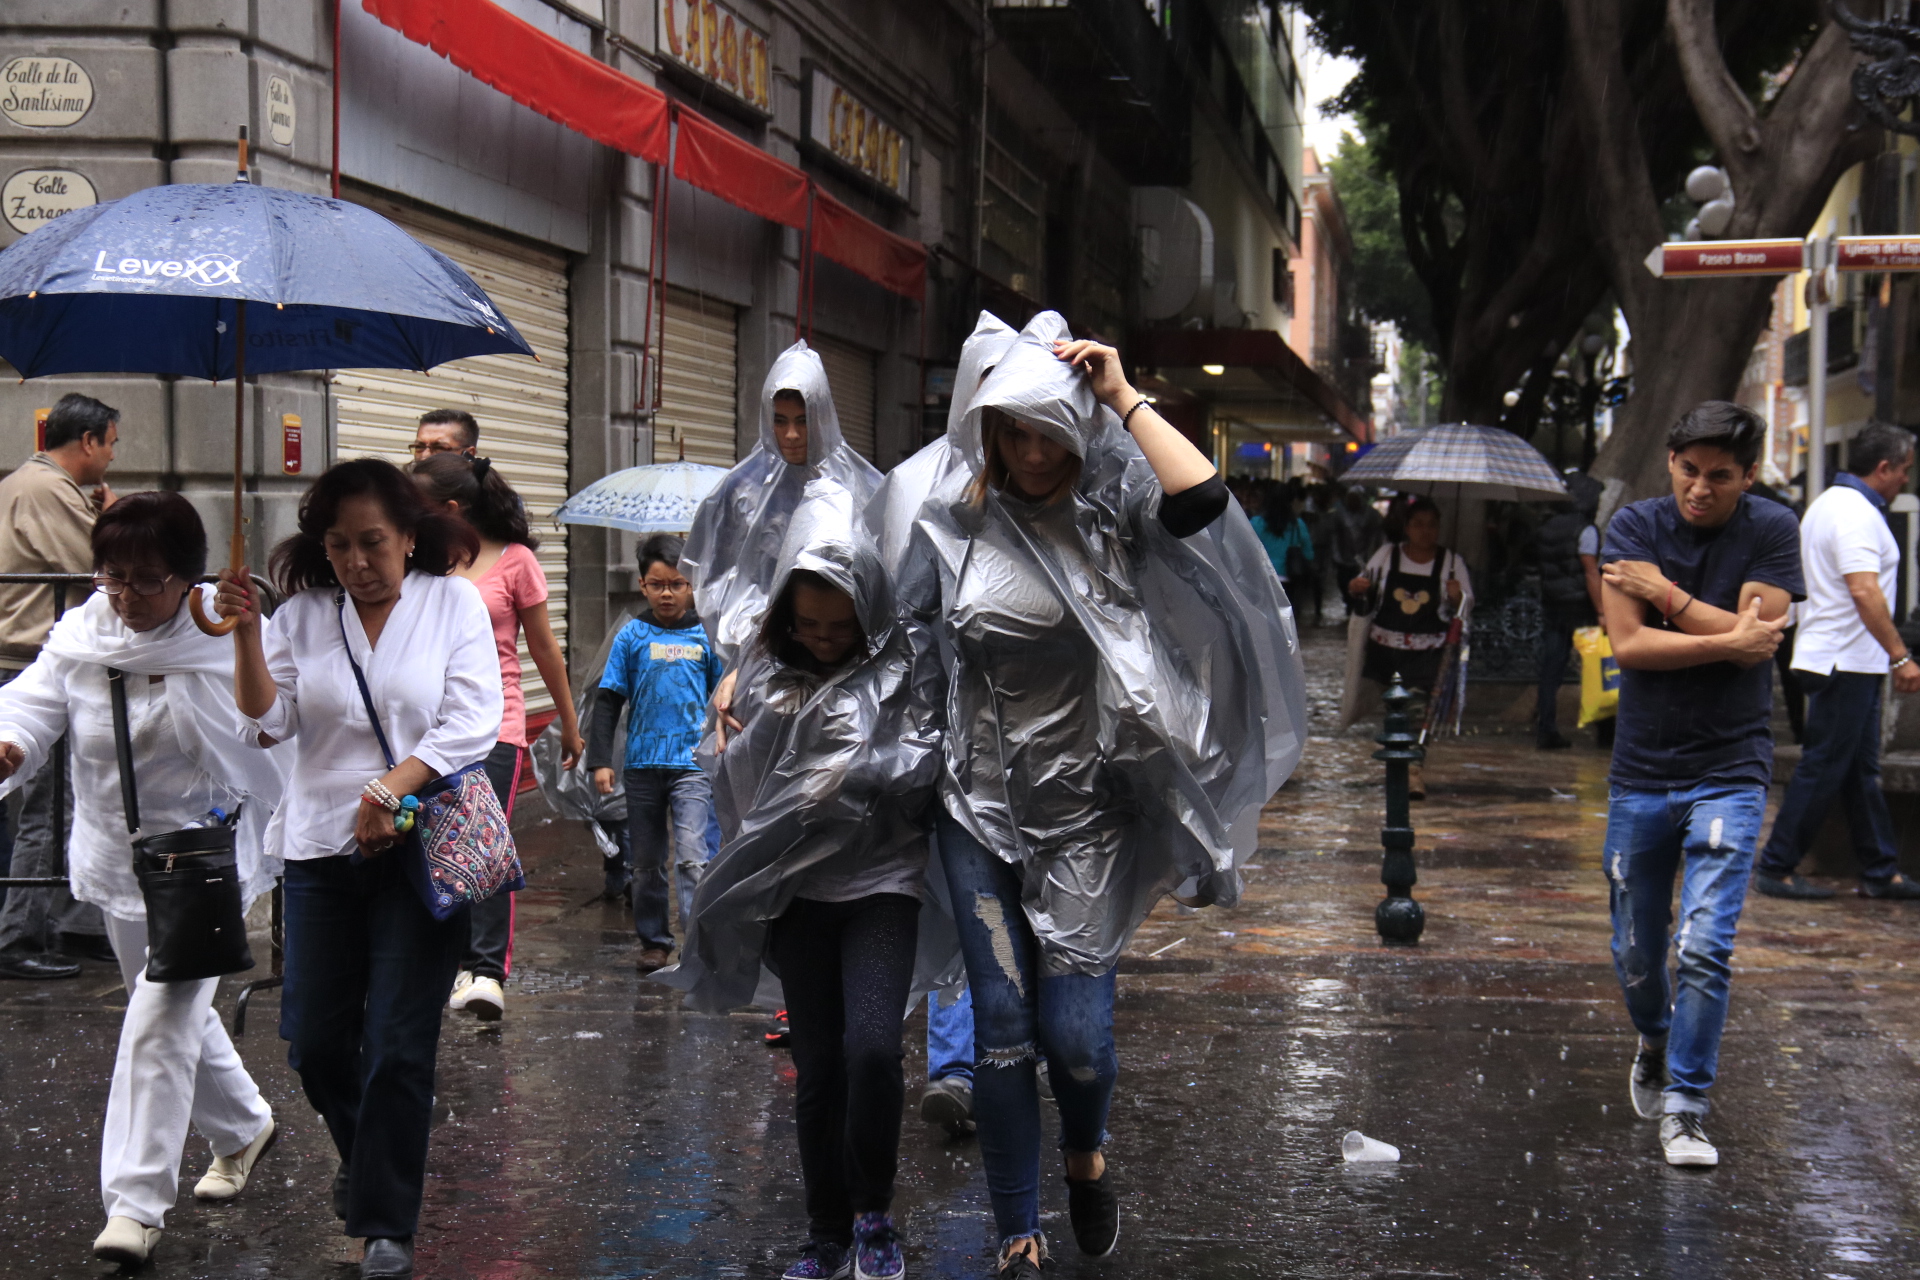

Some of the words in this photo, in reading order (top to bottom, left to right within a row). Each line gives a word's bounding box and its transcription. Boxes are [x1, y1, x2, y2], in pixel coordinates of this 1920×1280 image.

[6, 61, 43, 84] Calle
[46, 62, 61, 83] de
[63, 62, 78, 84] la
[3, 85, 84, 112] Santísima
[28, 175, 68, 195] Calle
[1699, 253, 1733, 265] Paseo
[1734, 251, 1767, 264] Bravo
[1882, 243, 1901, 254] del
